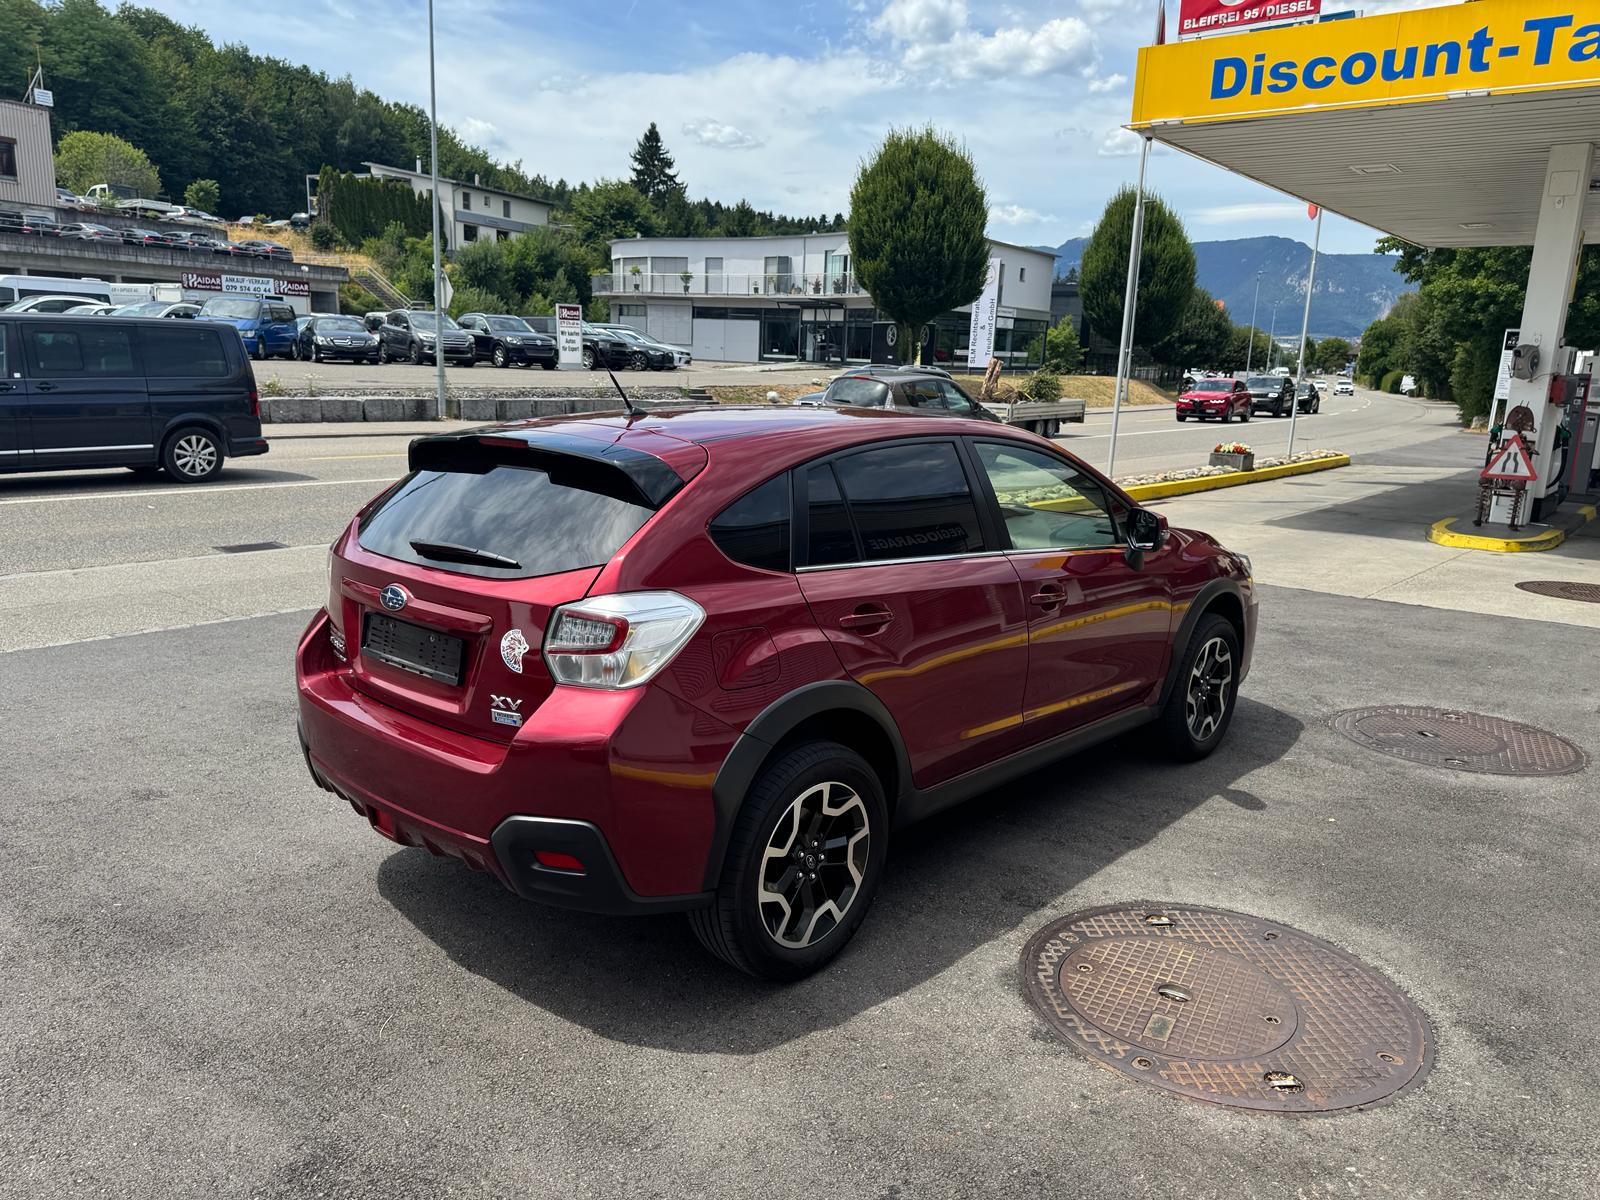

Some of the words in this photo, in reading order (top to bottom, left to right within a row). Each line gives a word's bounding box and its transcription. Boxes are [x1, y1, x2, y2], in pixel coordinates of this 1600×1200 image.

[1183, 13, 1240, 30] BLEIFREI
[1210, 14, 1600, 100] Discount-Ta
[985, 322, 994, 356] Treuhand
[1587, 362, 1593, 372] 1
[490, 694, 523, 711] XV
